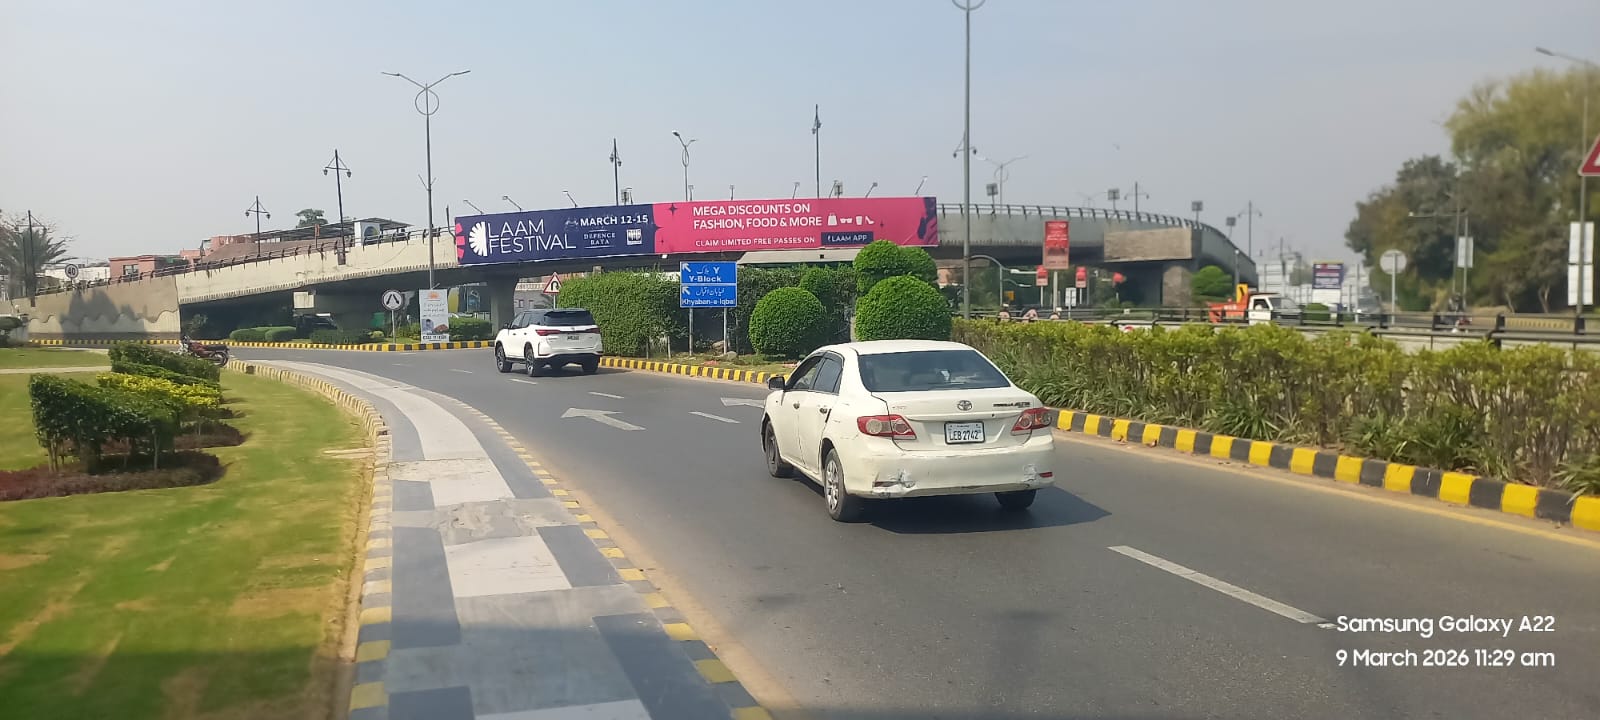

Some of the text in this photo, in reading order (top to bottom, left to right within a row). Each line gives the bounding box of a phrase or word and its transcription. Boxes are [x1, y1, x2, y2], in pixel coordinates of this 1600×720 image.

[693, 203, 811, 217] MEGA DISCOUNTS ON
[580, 217, 617, 226] MARCH
[620, 214, 649, 224] 12-15
[693, 215, 823, 231] FASHION, FOOD & MORE
[487, 218, 545, 239] LAAM
[584, 232, 616, 240] DEFENCE
[695, 236, 815, 247] CLAIM LIMITED FREE PASSES ON
[489, 234, 576, 254] FESTIVAL
[68, 267, 75, 275] 40
[949, 430, 962, 441] LEB
[963, 430, 979, 440] 2742
